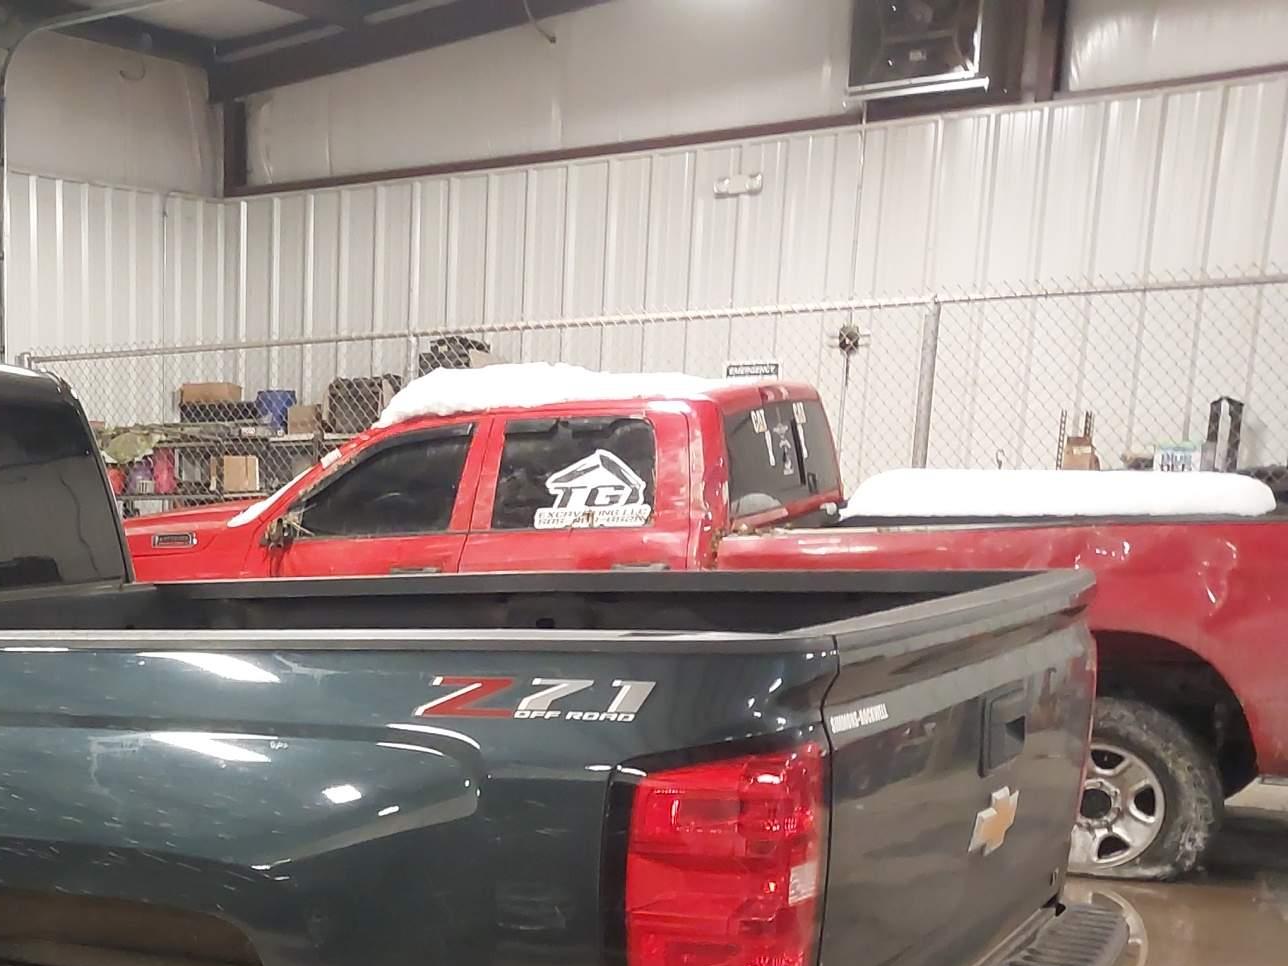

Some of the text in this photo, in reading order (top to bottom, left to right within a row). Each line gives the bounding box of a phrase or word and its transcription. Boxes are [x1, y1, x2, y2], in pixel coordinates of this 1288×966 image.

[414, 676, 657, 717] Z71
[513, 710, 636, 722] OFF ROAD
